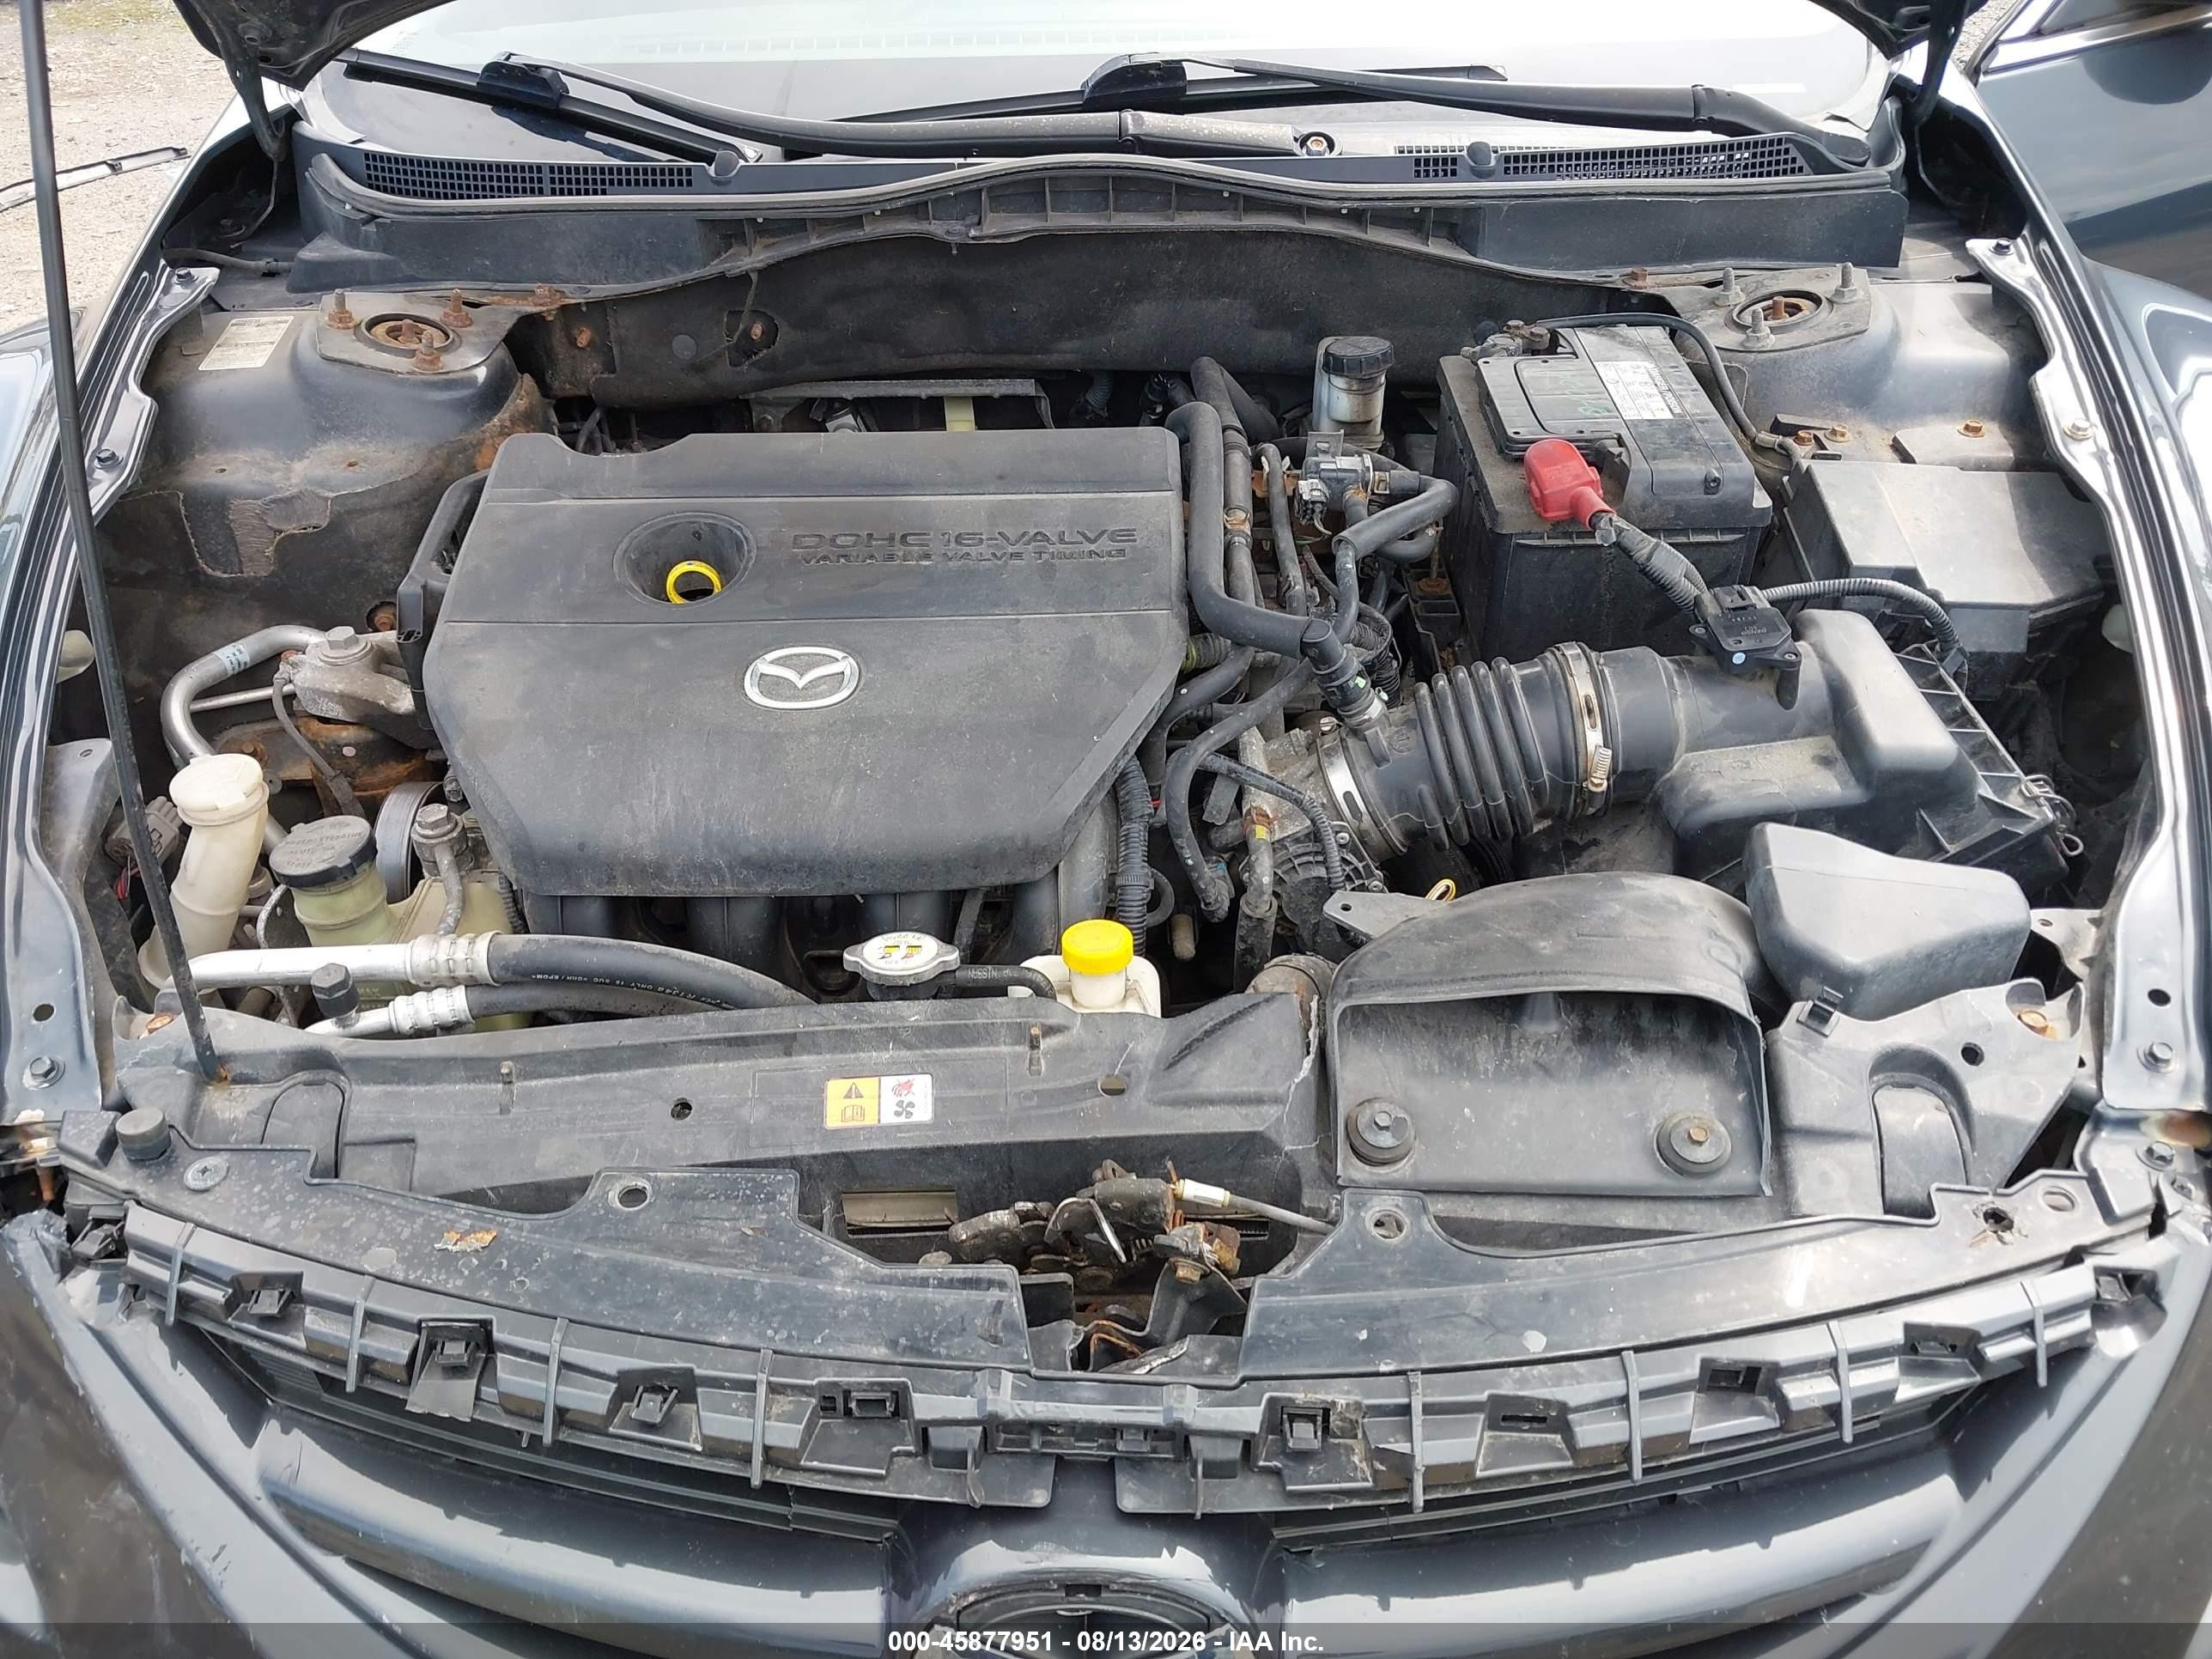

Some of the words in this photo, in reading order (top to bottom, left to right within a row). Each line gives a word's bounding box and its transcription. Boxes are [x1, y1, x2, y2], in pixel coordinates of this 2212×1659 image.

[792, 532, 933, 550] DOHC
[941, 528, 1138, 547] 16-VALVE
[801, 551, 933, 564] VARIABLE
[945, 550, 1025, 562] VALVE
[1034, 548, 1127, 562] TIMING
